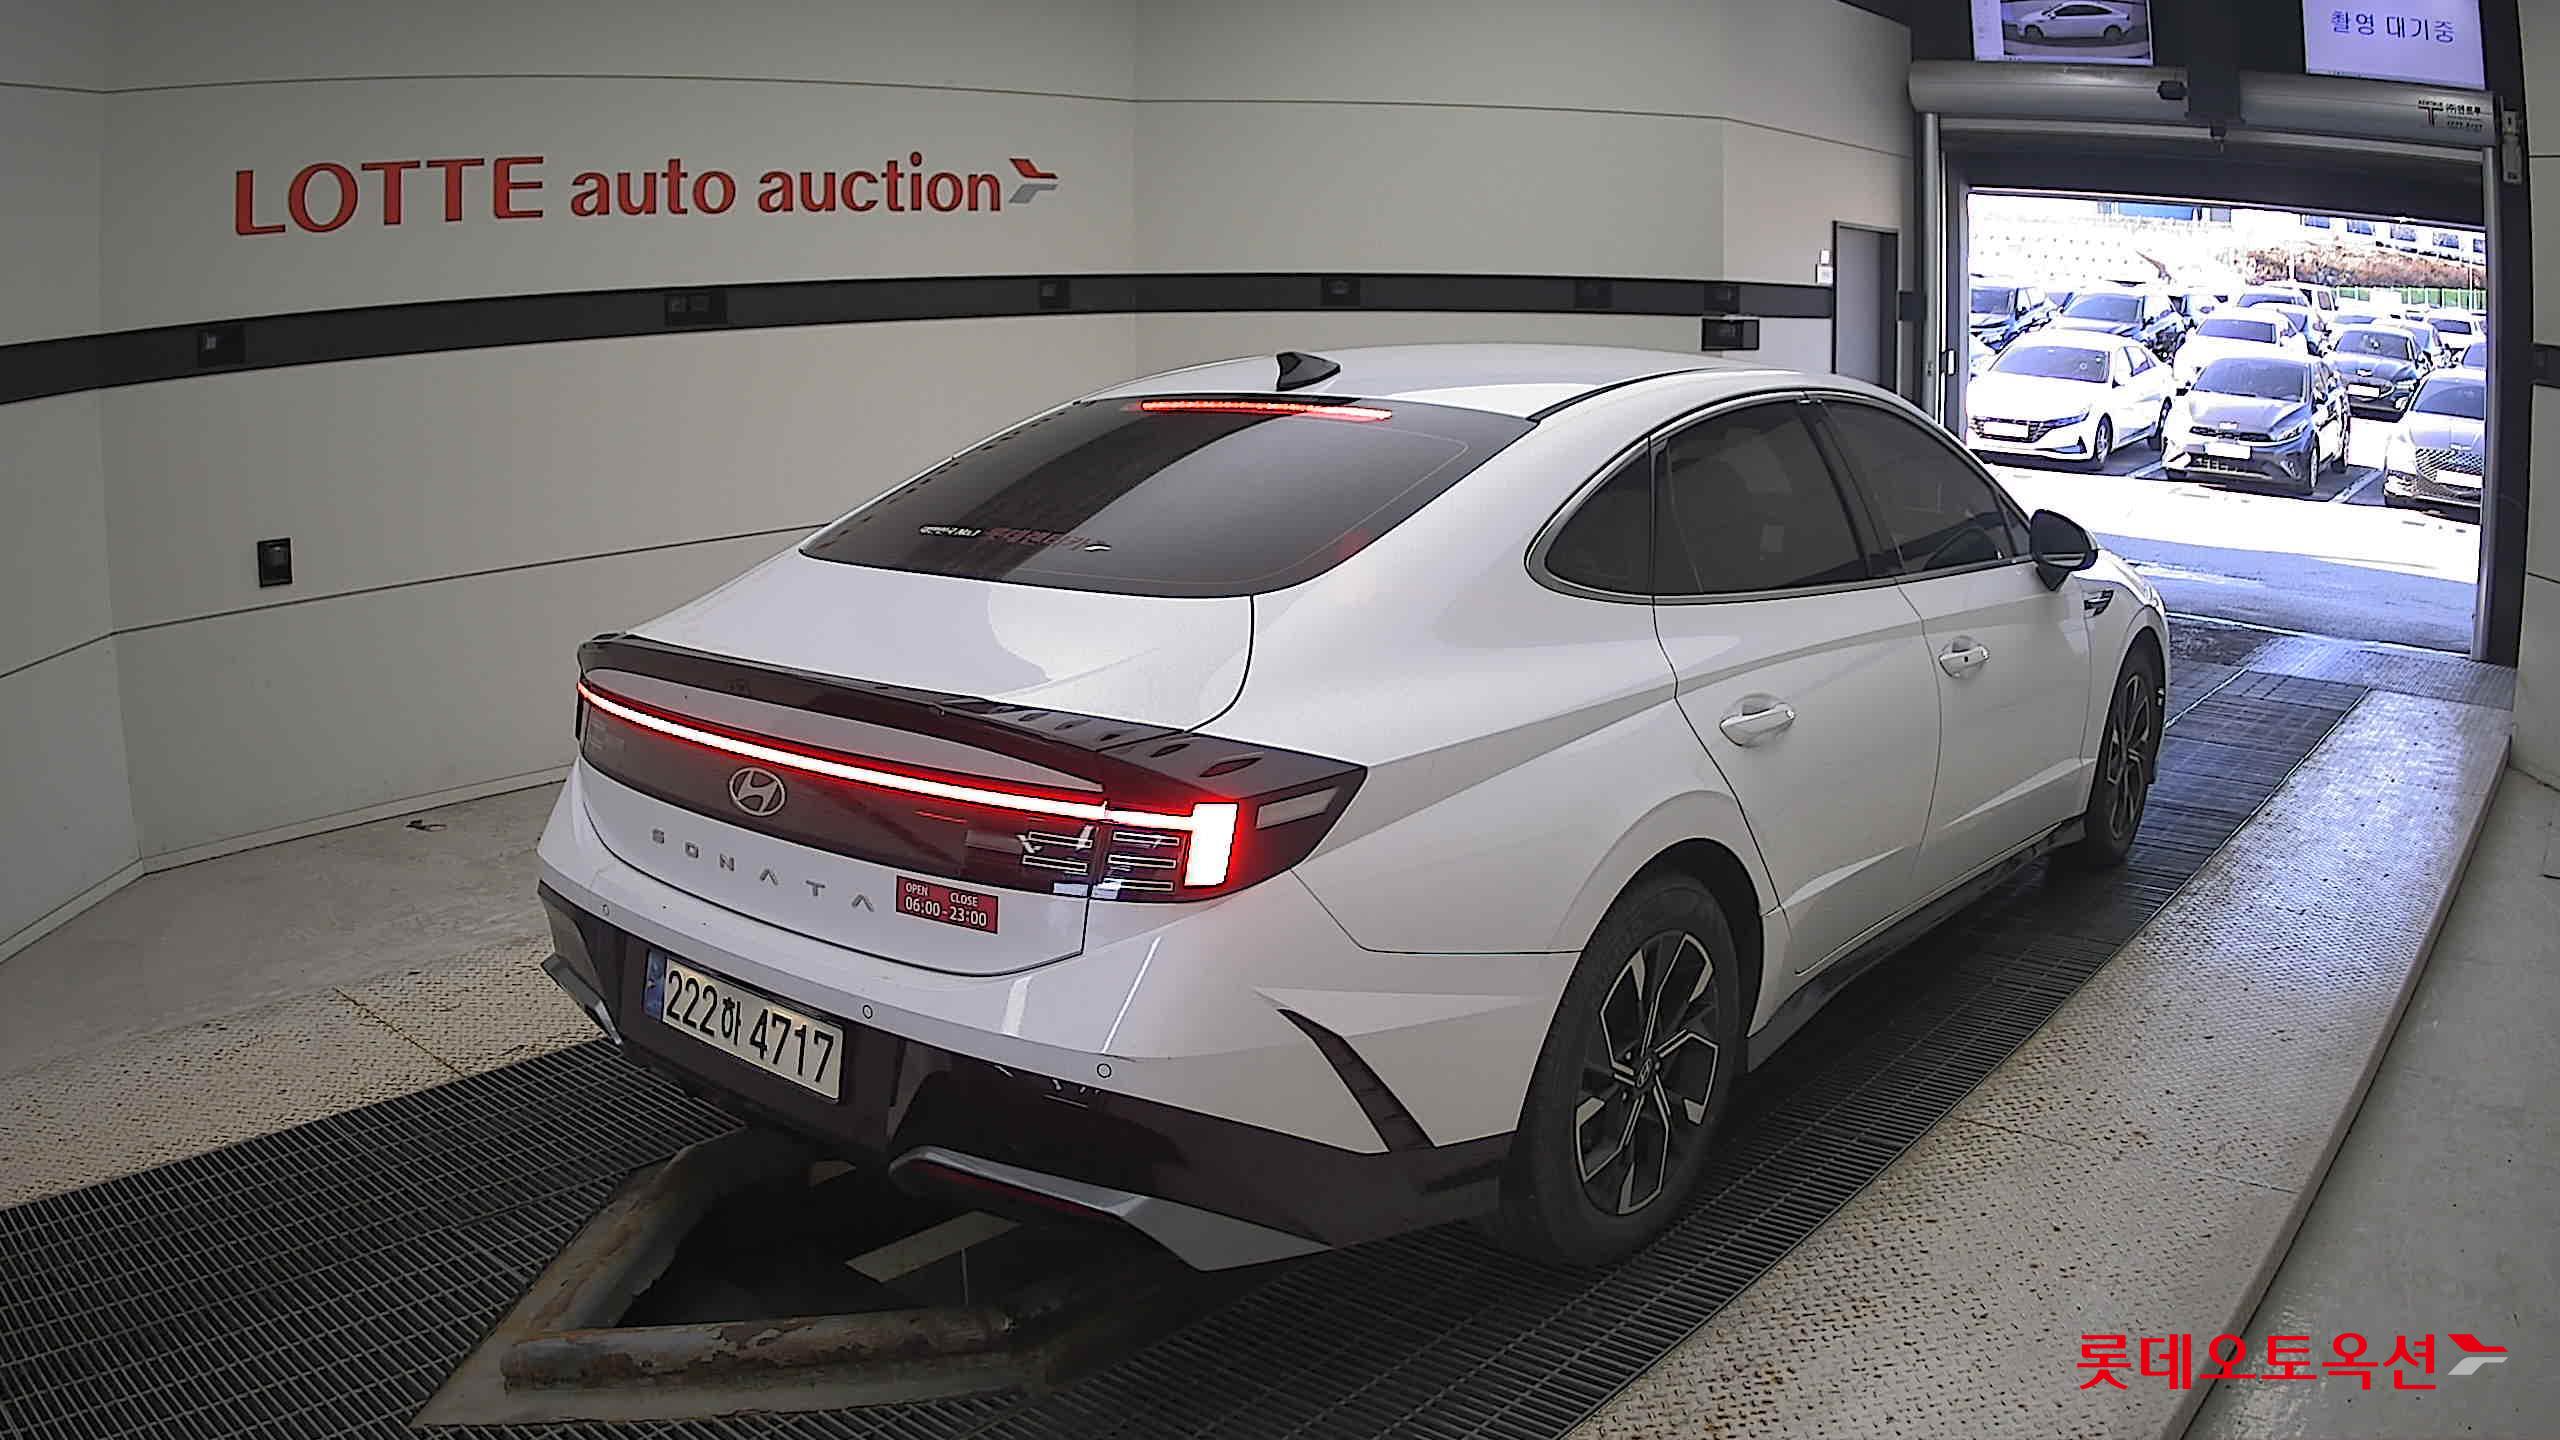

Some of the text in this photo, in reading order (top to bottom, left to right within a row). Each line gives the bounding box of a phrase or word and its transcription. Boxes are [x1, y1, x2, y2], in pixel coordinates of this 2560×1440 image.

[2331, 10, 2455, 44] 촬영 대기중
[235, 151, 1001, 236] LOTTE auto auction
[652, 829, 874, 912] SONATA
[905, 882, 978, 907] OPEN CLOSE
[666, 970, 834, 1083] 222하 4717
